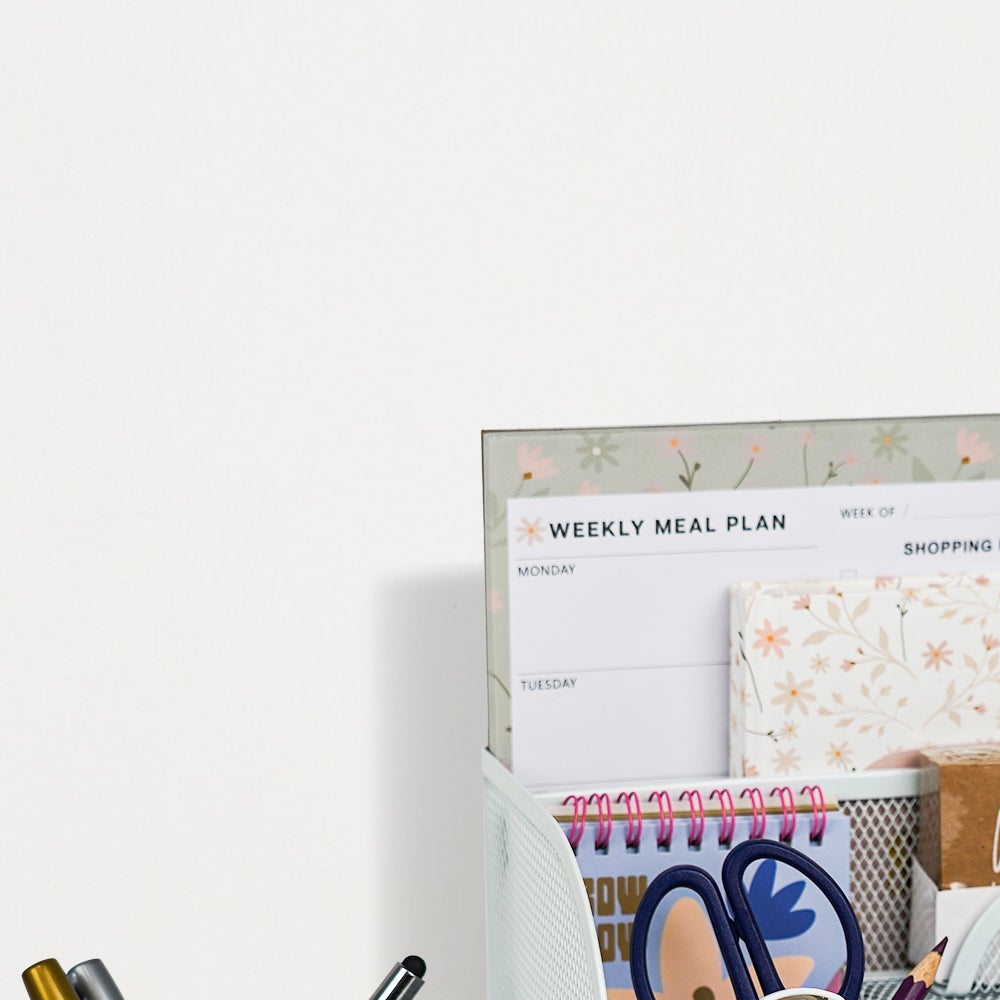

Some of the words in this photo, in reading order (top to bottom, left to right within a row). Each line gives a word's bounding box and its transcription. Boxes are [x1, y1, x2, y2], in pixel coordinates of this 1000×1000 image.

[840, 508, 874, 519] WEEK
[879, 506, 896, 517] OF
[550, 519, 645, 538] WEEKLY
[655, 517, 717, 535] MEAL
[727, 514, 786, 532] PLAN
[904, 539, 993, 556] SHOPPING
[518, 564, 576, 577] MONDAY
[520, 678, 577, 691] TUESDAY
